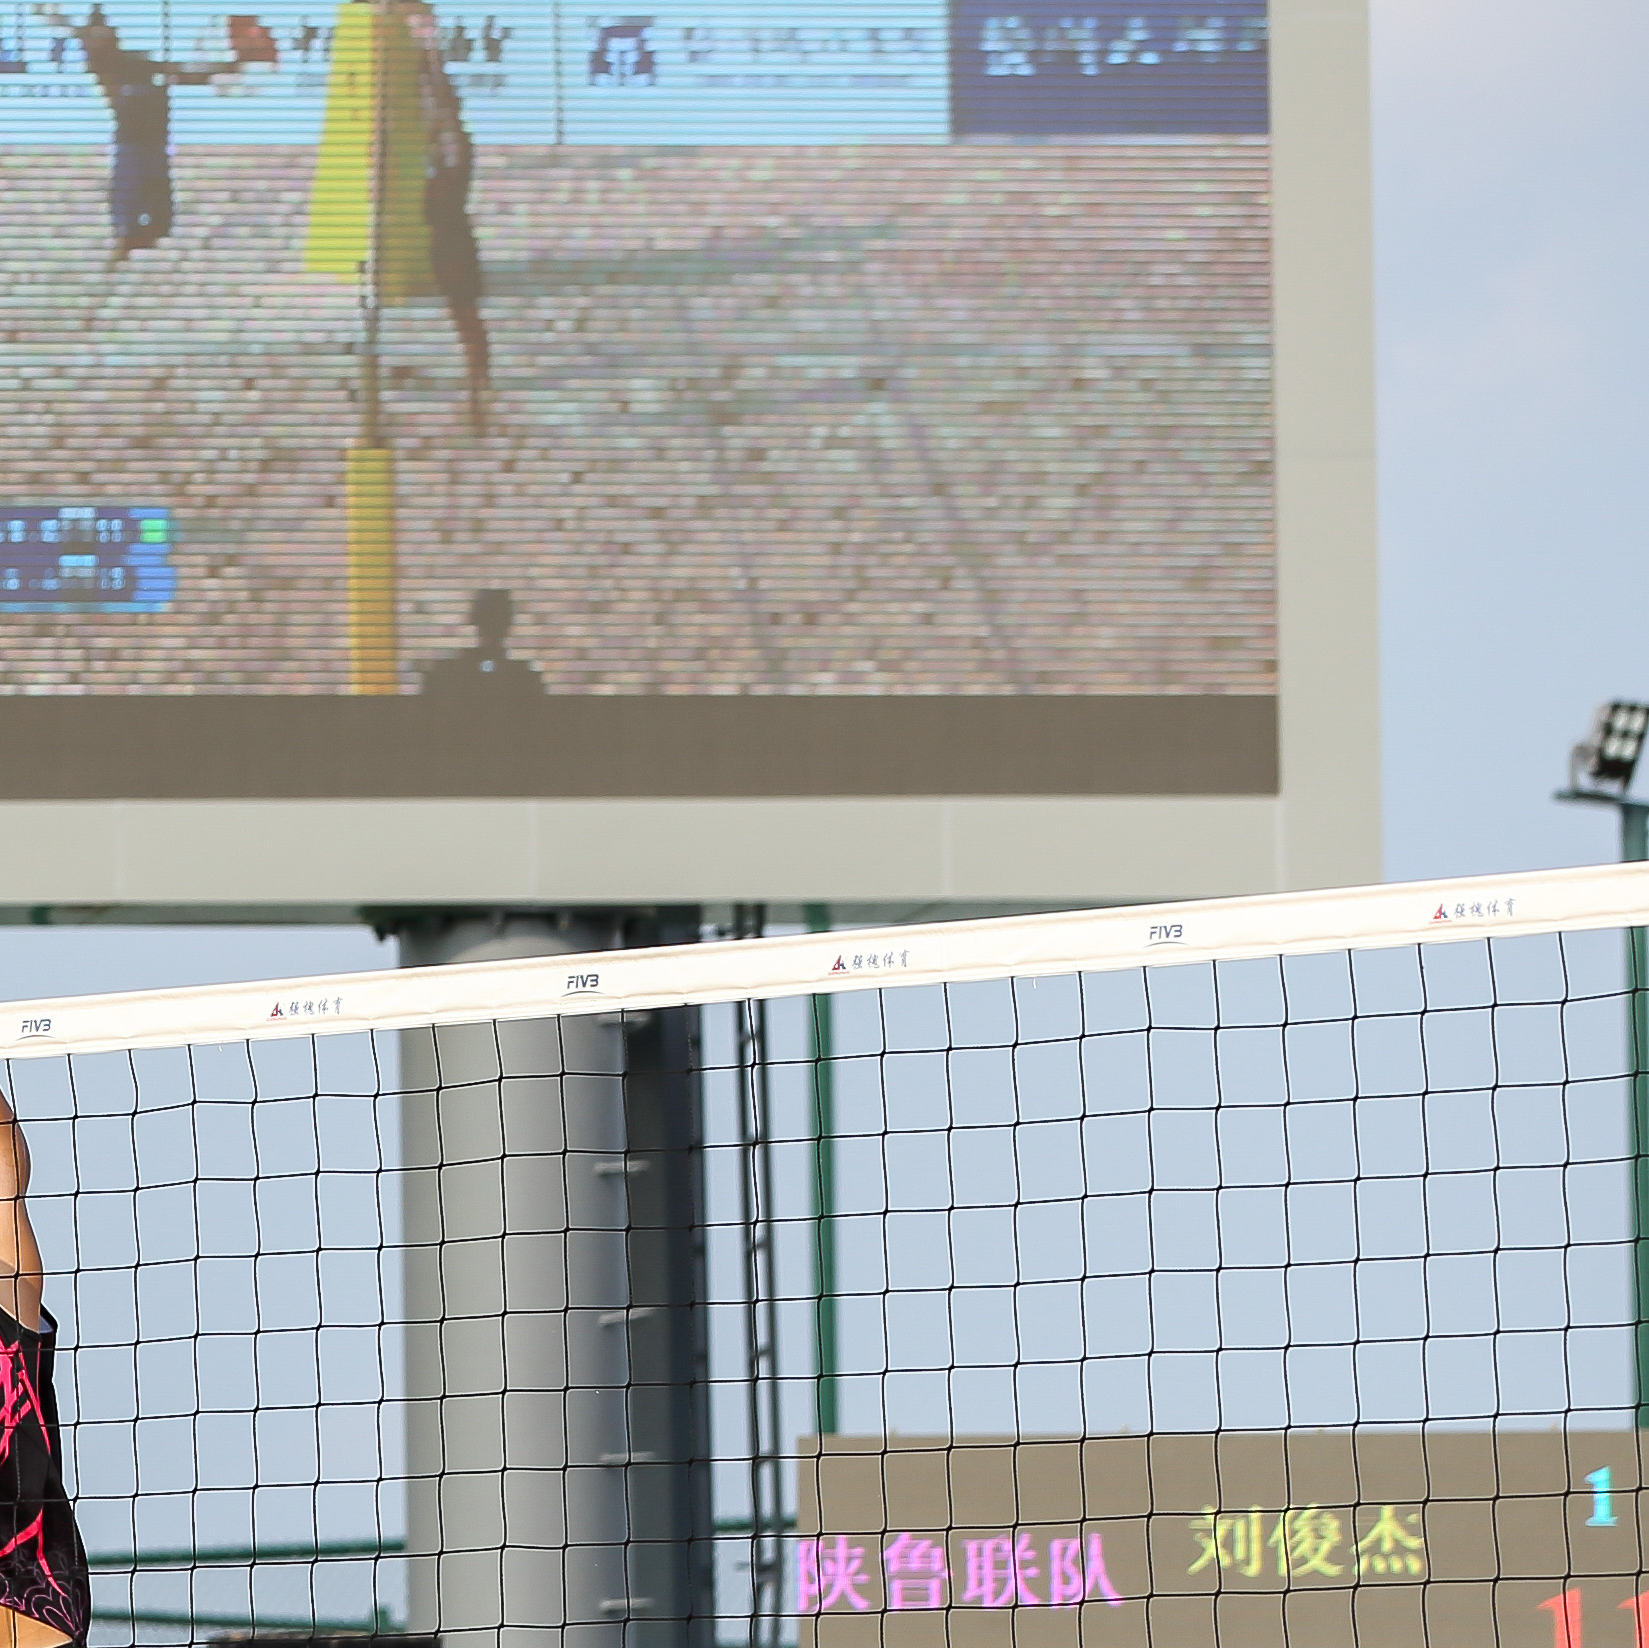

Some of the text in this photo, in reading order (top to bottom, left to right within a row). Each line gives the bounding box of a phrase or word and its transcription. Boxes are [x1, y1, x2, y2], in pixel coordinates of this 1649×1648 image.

[1149, 924, 1183, 939] FIVB
[567, 974, 599, 990] FIVB
[21, 1019, 52, 1033] FIVB
[1583, 1465, 1618, 1527] 1
[1186, 1502, 1428, 1578] 刘俊杰
[796, 1532, 1123, 1612] 陕鲁联队
